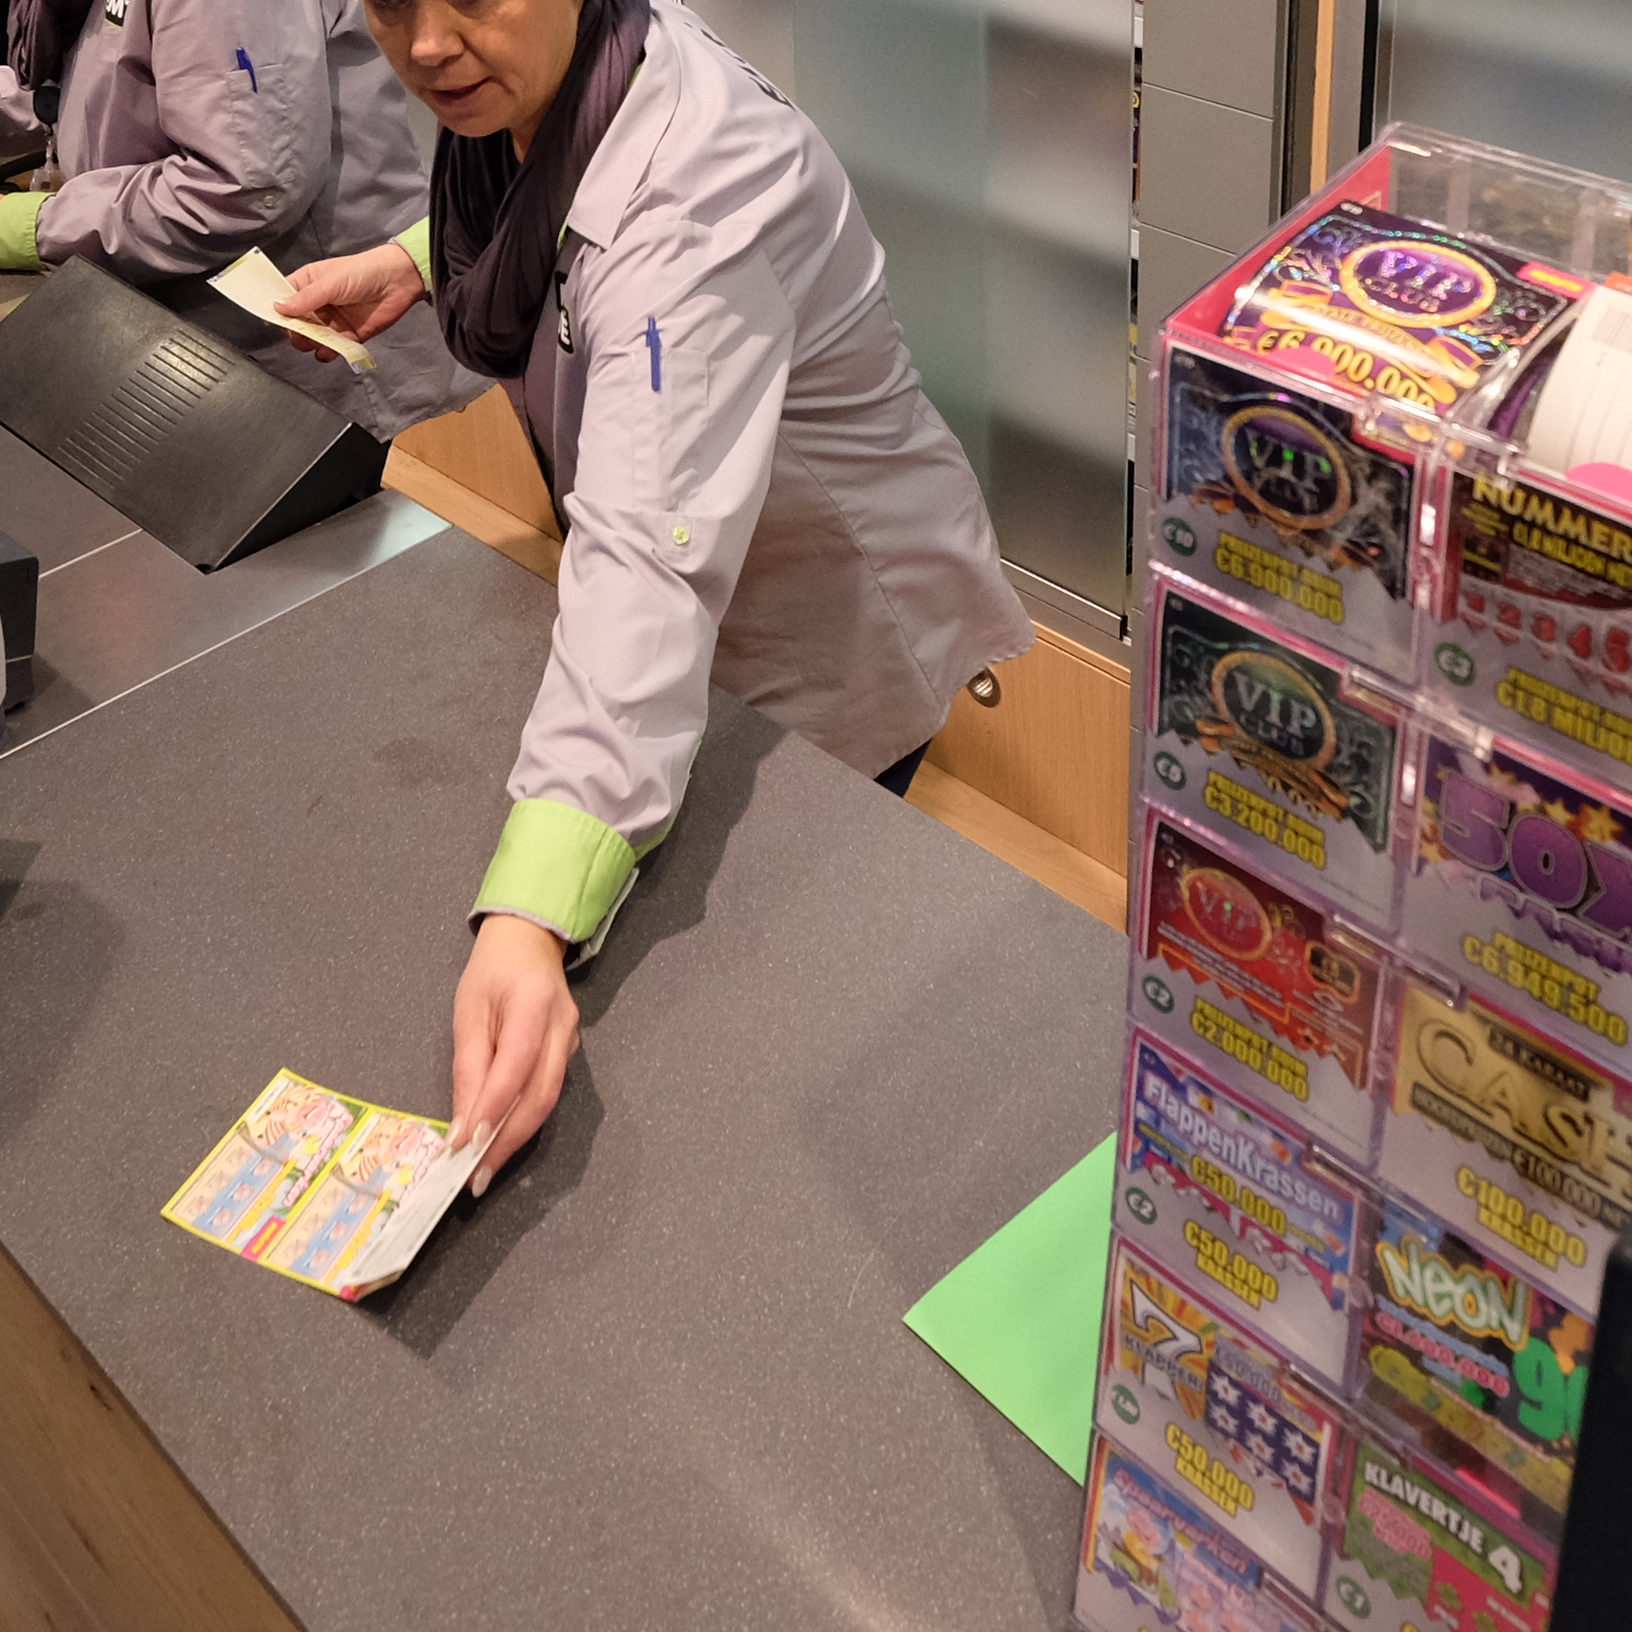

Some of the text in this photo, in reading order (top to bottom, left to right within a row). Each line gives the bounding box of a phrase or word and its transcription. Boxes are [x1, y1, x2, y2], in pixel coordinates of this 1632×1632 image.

[1234, 672, 1317, 738] VIP
[1462, 934, 1628, 1047] €6.949.500
[1144, 1071, 1340, 1220] FlappenKrassen
[1183, 1220, 1279, 1303] €50.000
[1456, 1166, 1586, 1267] €100.000
[1124, 1334, 1199, 1388] KLAPPER
[1166, 1422, 1255, 1512] €50.000
[1364, 1461, 1522, 1593] KLAVERTJE 4
